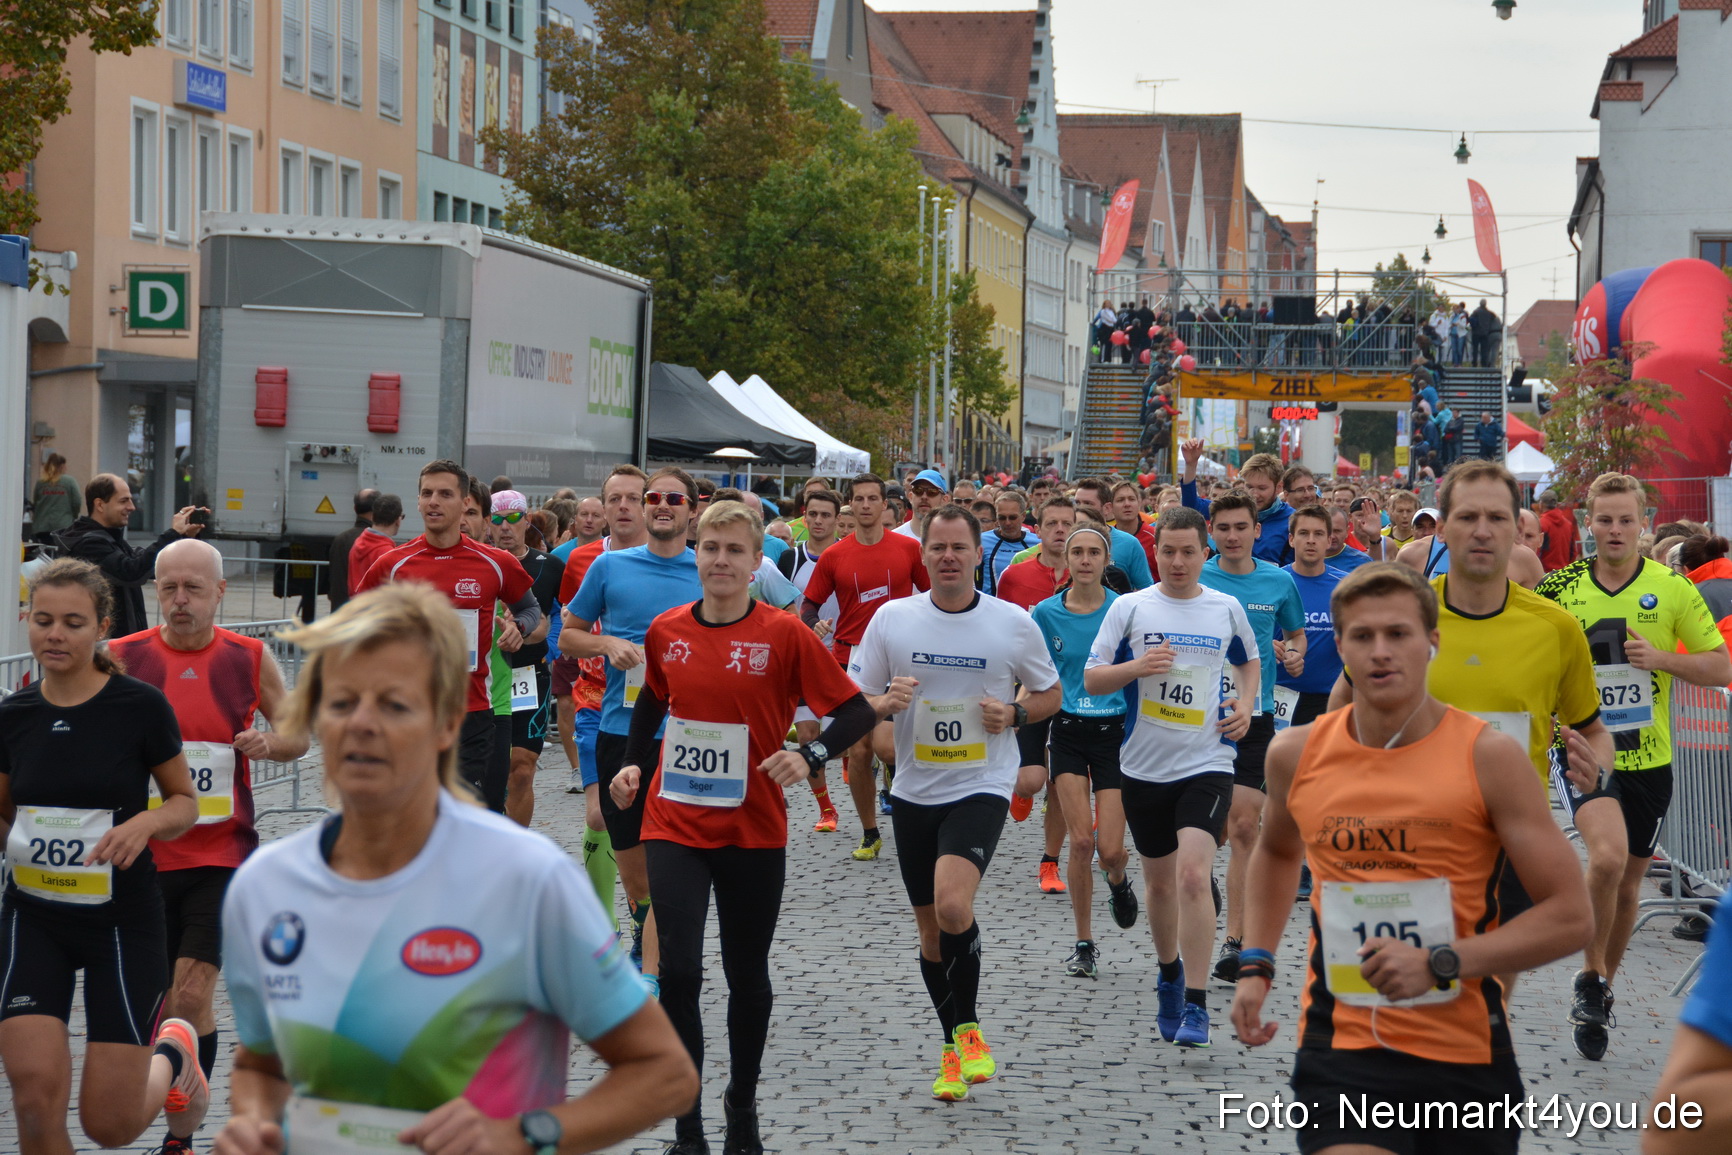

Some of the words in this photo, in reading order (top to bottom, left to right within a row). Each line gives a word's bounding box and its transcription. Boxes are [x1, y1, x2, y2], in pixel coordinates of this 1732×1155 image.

[138, 280, 179, 322] D
[488, 339, 512, 377] OFFICE
[514, 344, 547, 381] INDUSTRY
[547, 350, 573, 385] LOUNGE
[588, 340, 634, 413] BOCK
[1270, 378, 1322, 397] ZIEL
[381, 445, 395, 454] NM
[407, 446, 426, 455] 1106
[1247, 603, 1275, 612] BOCK
[1637, 612, 1658, 621] Partl
[1168, 634, 1219, 648] BÜSCHEL
[932, 655, 984, 668] BÜSCHEL
[1159, 681, 1193, 705] 146
[936, 704, 965, 713] BOCK
[1077, 697, 1094, 708] 18.
[1076, 707, 1115, 715] Neumarkter
[1159, 707, 1186, 719] Markus
[692, 729, 722, 738] BOCK
[934, 720, 962, 742] 60
[185, 749, 210, 757] OCK
[673, 744, 730, 774] 2301
[930, 749, 968, 760] Wolfgang
[688, 780, 714, 792] Seger
[44, 817, 81, 826] BOCK
[1331, 828, 1417, 853] OEXL
[29, 838, 85, 867] 262
[1377, 862, 1417, 871] VISION
[41, 874, 77, 888] Larissa
